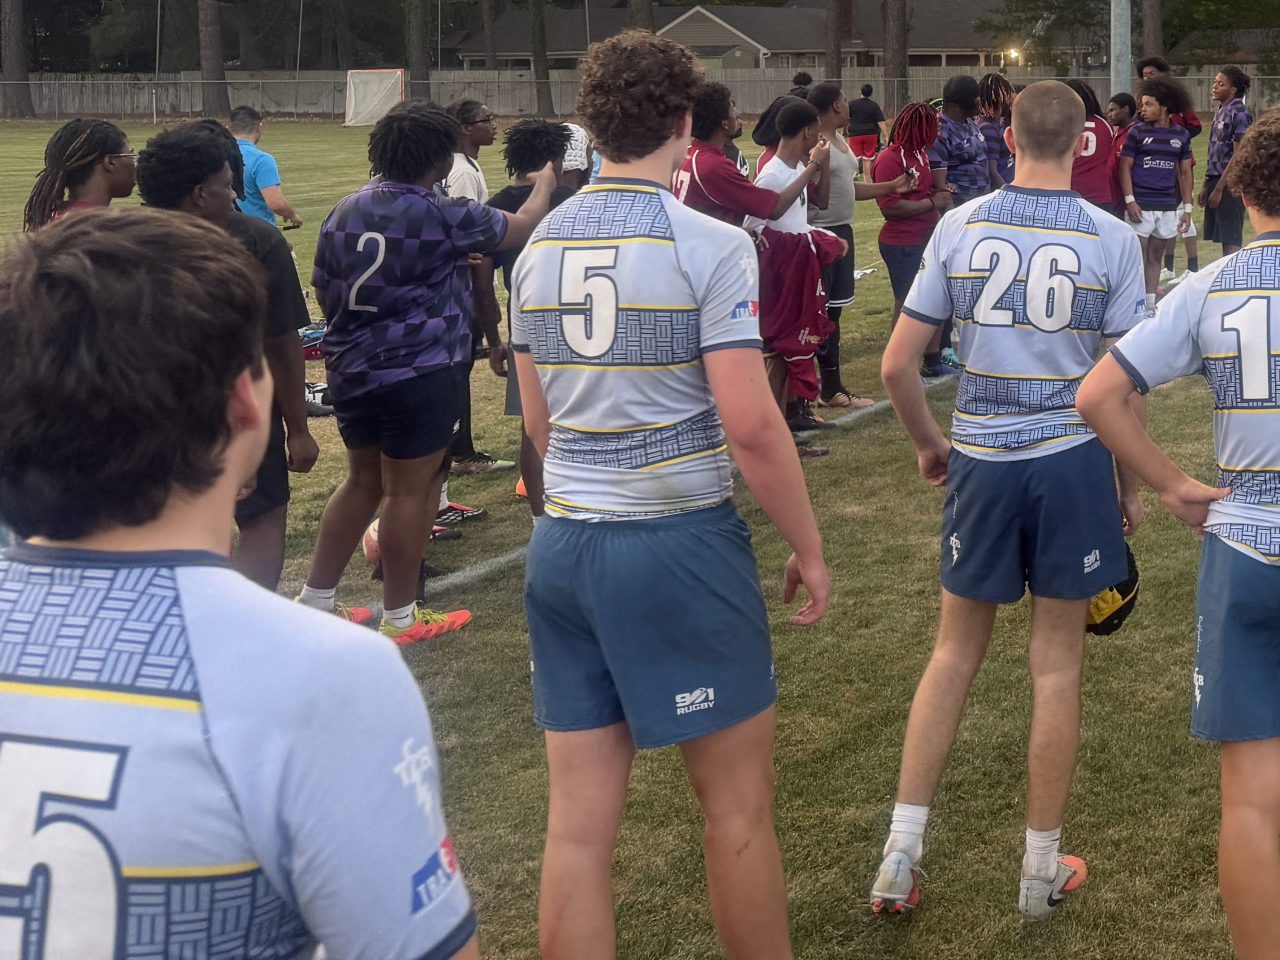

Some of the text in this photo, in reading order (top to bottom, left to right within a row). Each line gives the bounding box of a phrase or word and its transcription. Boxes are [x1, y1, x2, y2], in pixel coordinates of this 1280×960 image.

[349, 231, 386, 313] 2
[557, 246, 619, 358] 5
[969, 236, 1081, 333] 26
[675, 687, 715, 708] 901
[676, 700, 715, 716] RUGBY
